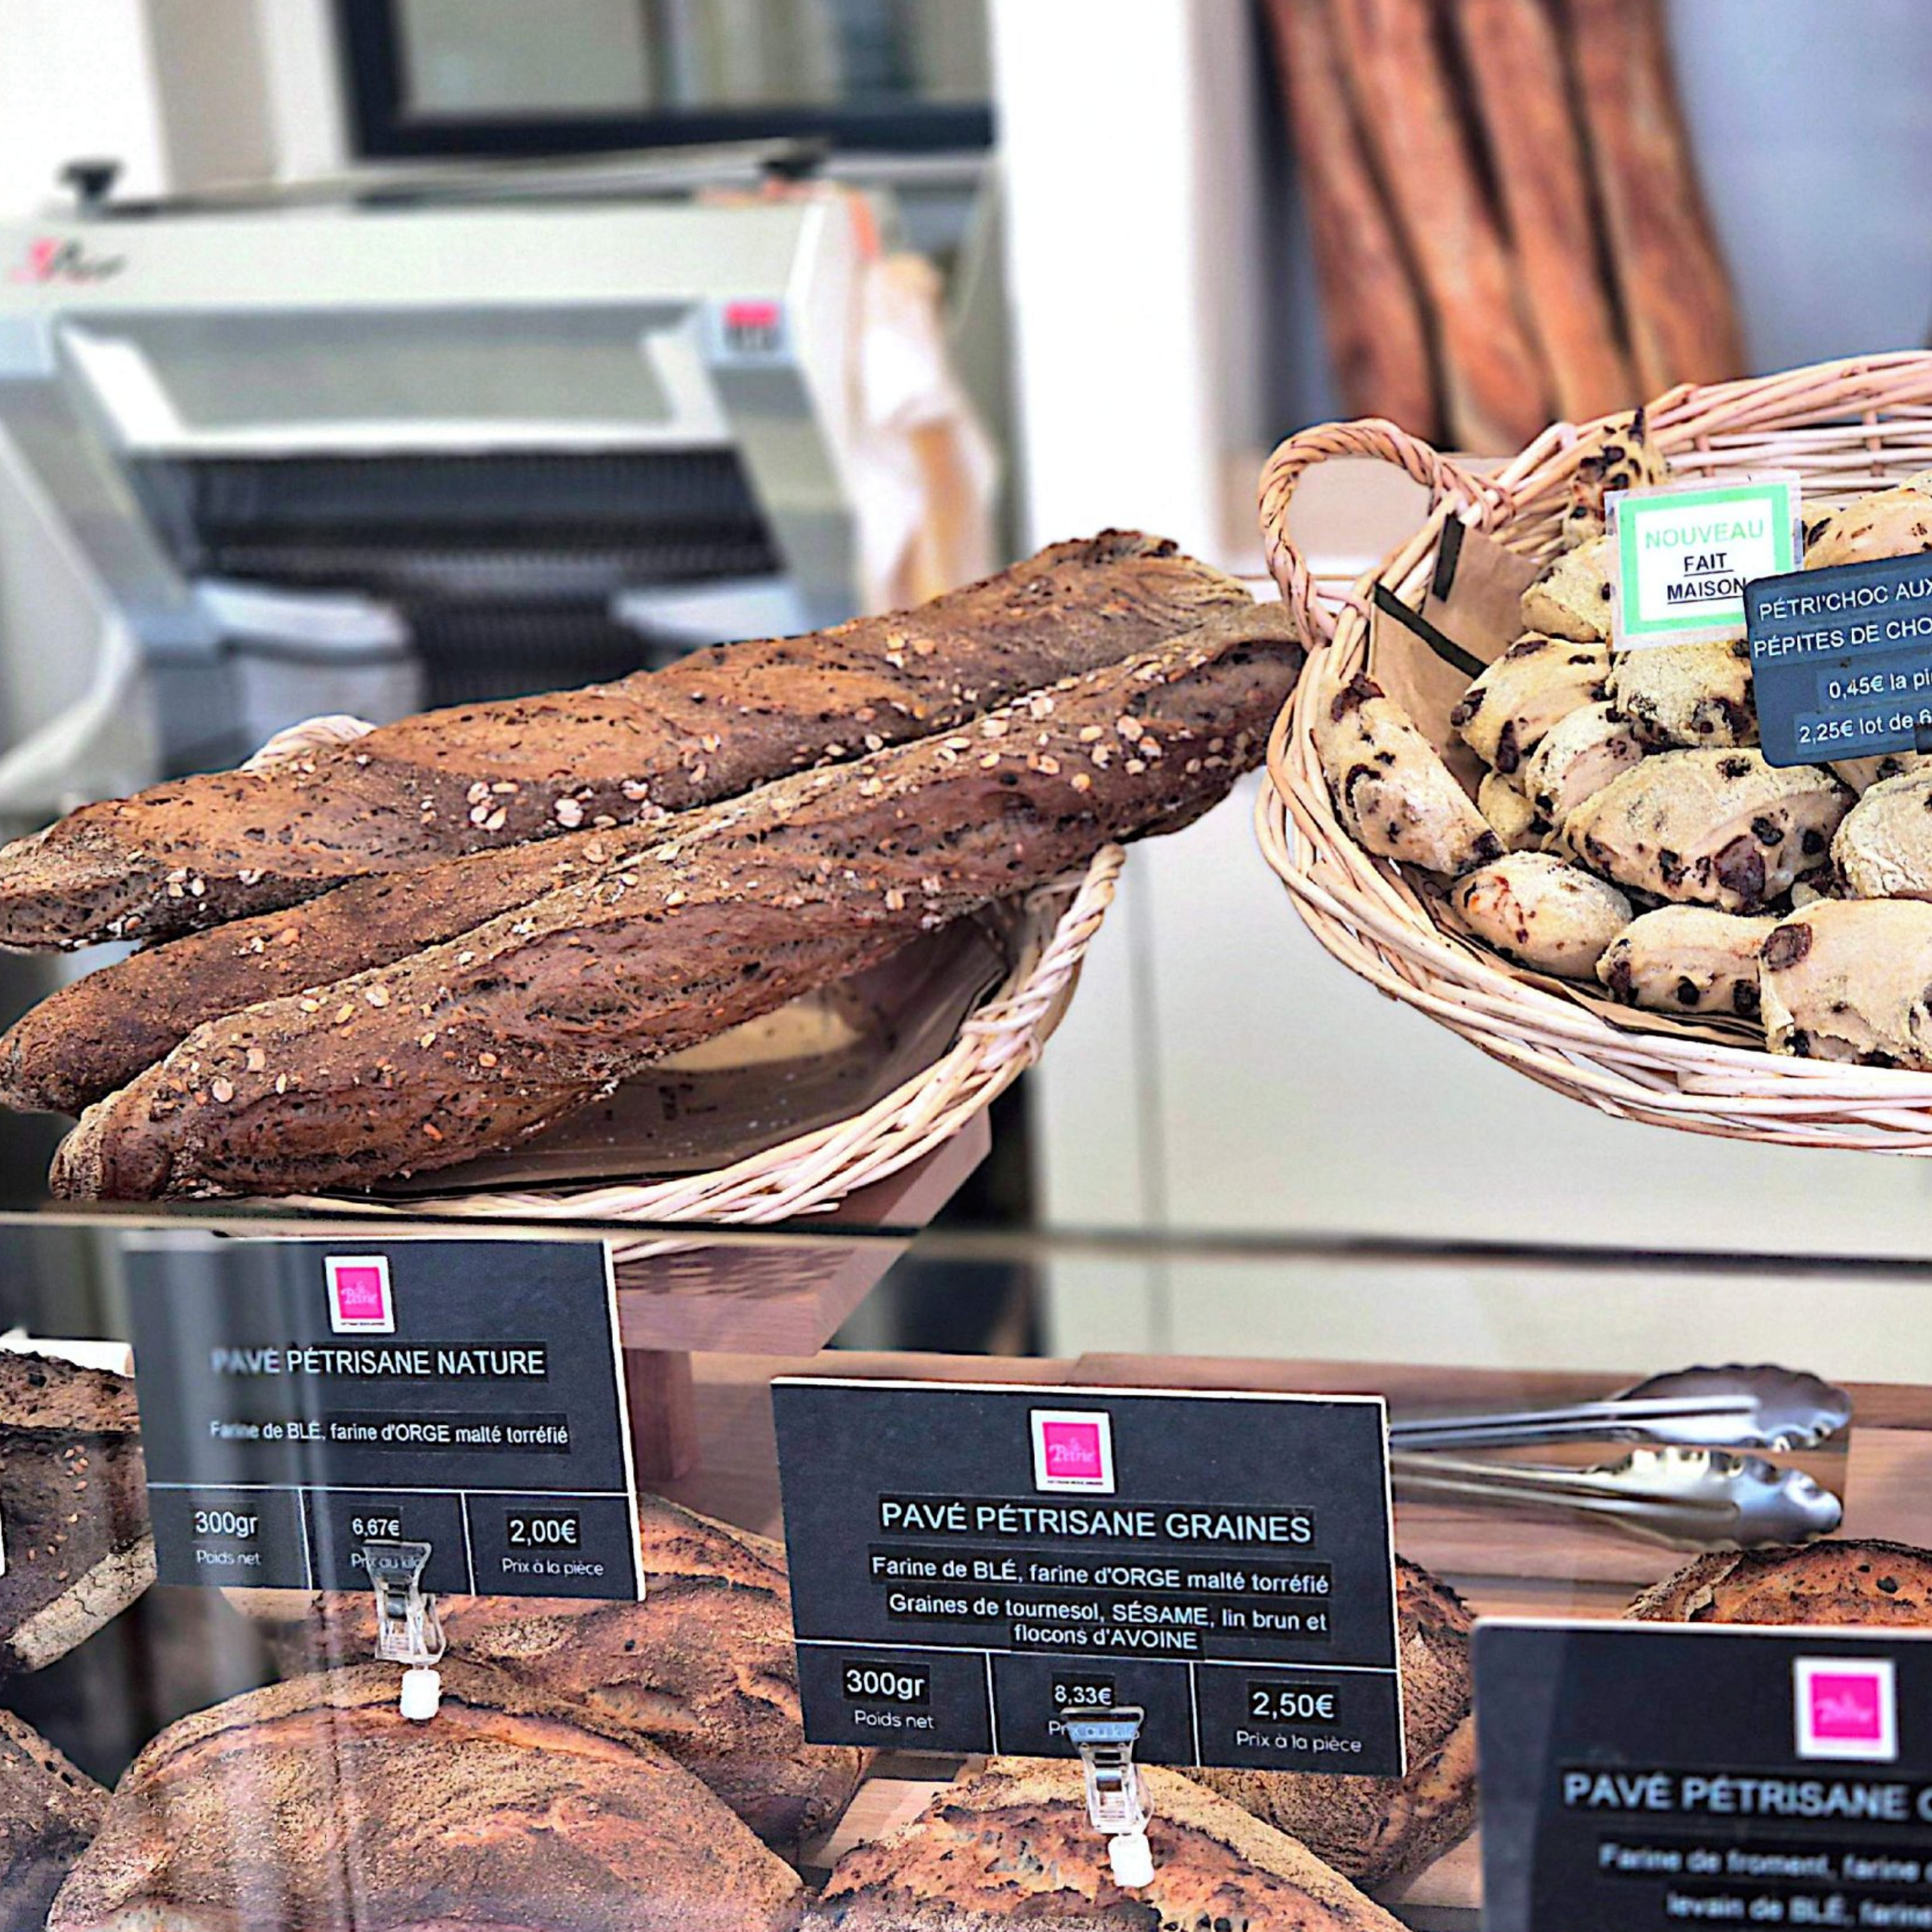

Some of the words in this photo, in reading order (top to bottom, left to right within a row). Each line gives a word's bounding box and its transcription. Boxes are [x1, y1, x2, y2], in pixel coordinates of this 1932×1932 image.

[1644, 519, 1763, 549] NOUVEAU
[1684, 552, 1727, 572] FAIT
[1666, 577, 1746, 601] MAISON
[1759, 586, 1888, 621] PÉTRI'CHOC
[1754, 629, 1845, 659] PÉPITES
[1851, 625, 1880, 645] DE
[1829, 675, 1884, 699] 0,45€
[1890, 672, 1907, 691] la
[1913, 667, 1932, 691] pi
[1799, 720, 1854, 744] 2,25€
[1860, 716, 1884, 735] lot
[1889, 712, 1913, 731] de
[211, 1346, 281, 1374] PAVÉ
[287, 1346, 431, 1374] PÉTRISANE
[438, 1350, 545, 1374] NATURE
[263, 1423, 283, 1438] de
[287, 1421, 326, 1440] BLÉ,
[331, 1423, 377, 1440] farine
[381, 1423, 451, 1442] d'ORGE
[455, 1426, 501, 1443] malté
[506, 1426, 568, 1444] torréfié
[195, 1511, 259, 1538] 300gr
[352, 1518, 400, 1537] 6,67€
[510, 1519, 577, 1546] 2,00€
[881, 1503, 967, 1531] PAVÉ
[977, 1504, 1156, 1537] PÉTRISANE
[1165, 1513, 1311, 1543] GRAINES
[196, 1549, 235, 1565] Poids
[238, 1553, 261, 1566] net
[502, 1558, 528, 1573] Prix
[533, 1559, 543, 1574] à
[547, 1559, 560, 1574] la
[564, 1560, 604, 1577] pièce
[872, 1556, 937, 1577] Farine
[943, 1560, 967, 1577] de
[973, 1558, 1023, 1583] BLÉ,
[1029, 1564, 1088, 1583] farine
[1094, 1567, 1180, 1588] d'ORGE
[1187, 1571, 1245, 1590] malté
[1251, 1573, 1328, 1594] torréfié
[889, 1593, 968, 1613] Graines
[973, 1598, 998, 1615] de
[1005, 1598, 1105, 1623] tournesol,
[1112, 1601, 1214, 1628] SÉSAME,
[1222, 1608, 1245, 1626] lin
[1253, 1610, 1300, 1630] brun
[1306, 1614, 1327, 1631] et
[1014, 1624, 1088, 1645] flocons
[1093, 1629, 1198, 1650] d'AVOINE
[846, 1669, 925, 1700] 300gr
[1054, 1684, 1112, 1706] 8,33€
[854, 1709, 902, 1727] Poids
[906, 1715, 935, 1729] net
[1253, 1691, 1334, 1720] 2,50€
[1236, 1730, 1270, 1747] Prix
[1275, 1734, 1287, 1749] à
[1291, 1734, 1308, 1750] la
[1312, 1736, 1361, 1754] pièce
[1563, 1771, 1672, 1810] PAVÉ
[1681, 1774, 1909, 1821] PÉTRISANE
[1686, 1846, 1721, 1873] de
[1749, 1895, 1784, 1921] de
